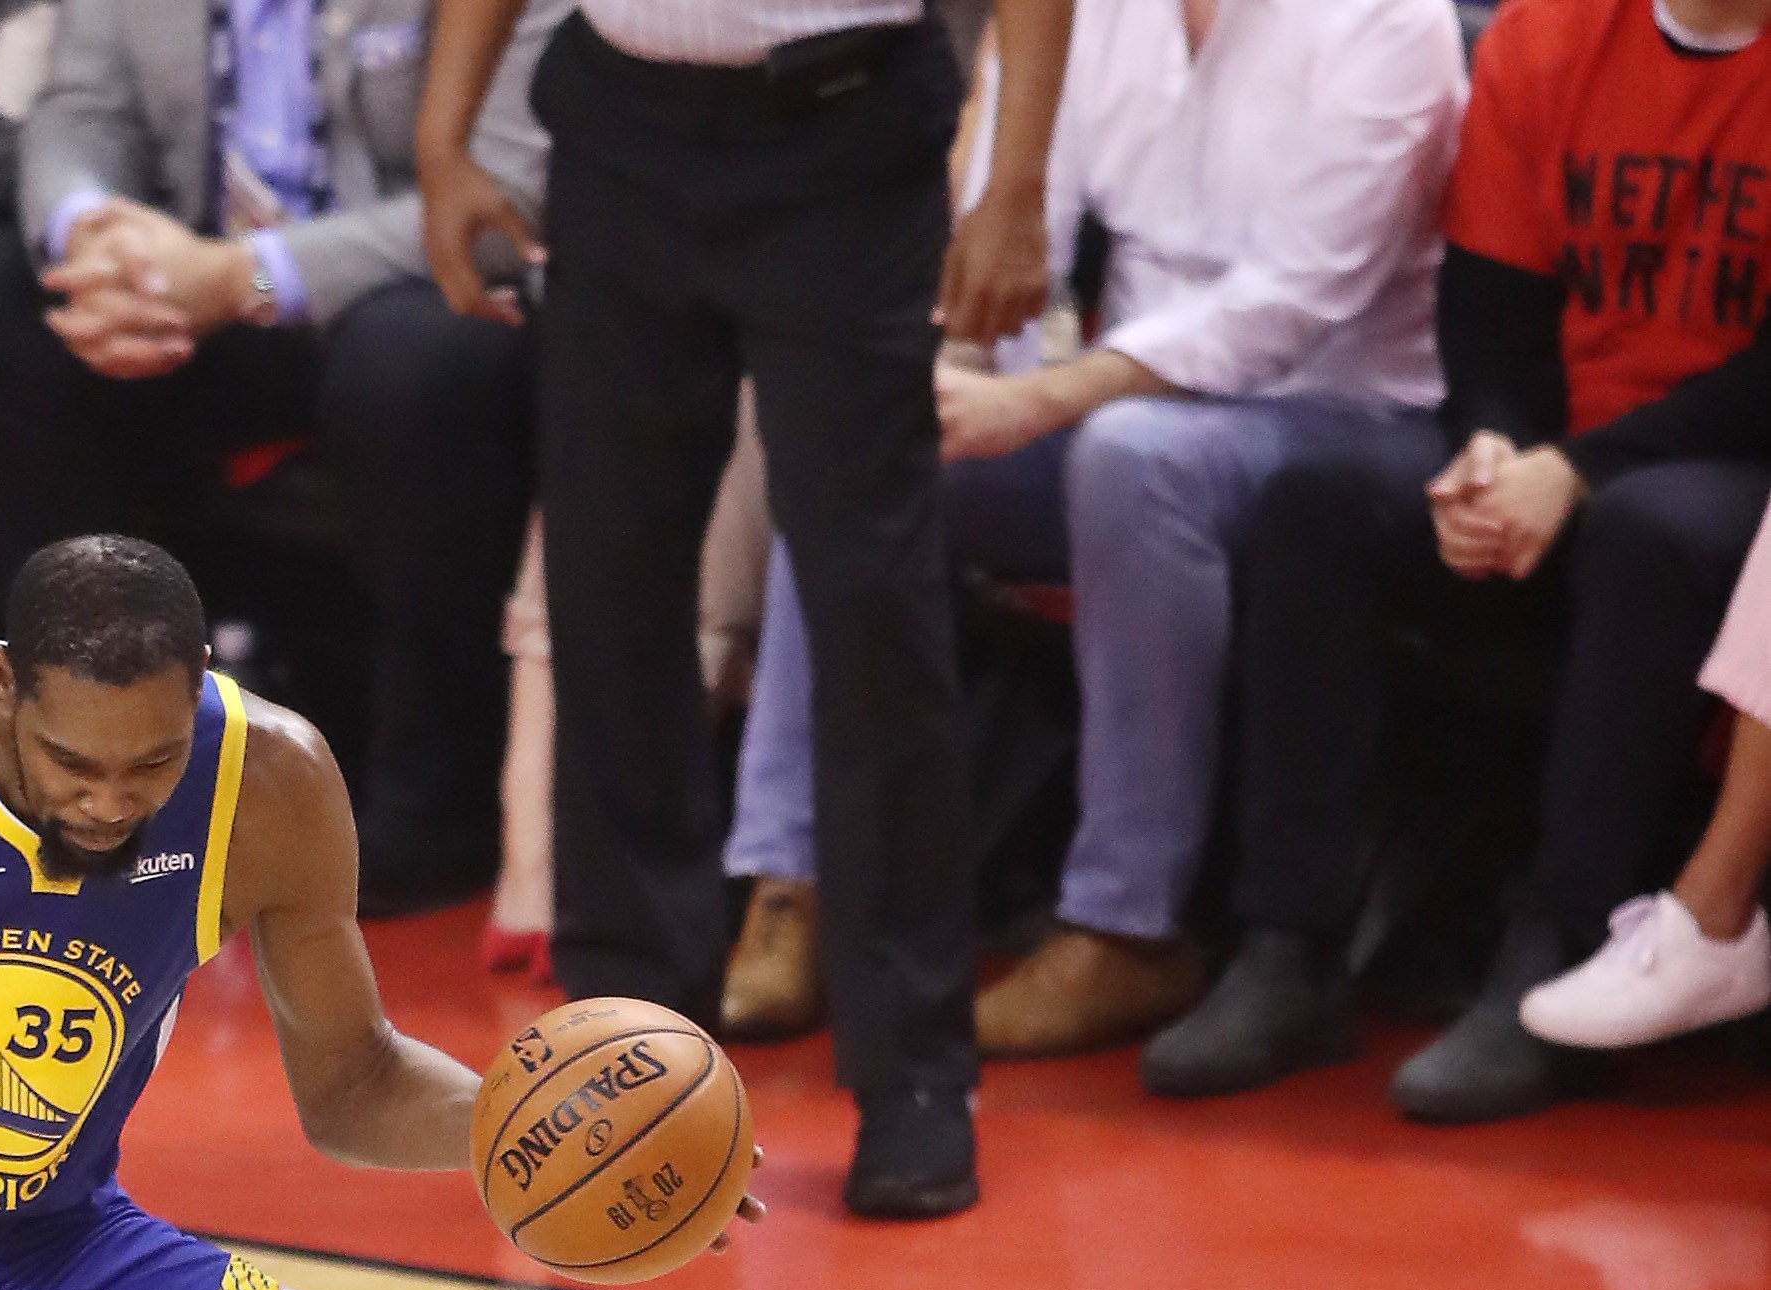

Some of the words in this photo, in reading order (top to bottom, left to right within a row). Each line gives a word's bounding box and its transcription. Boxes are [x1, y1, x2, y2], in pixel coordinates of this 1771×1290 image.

[135, 851, 195, 876] kuten
[64, 939, 142, 1005] STATE
[6, 1005, 98, 1064] 35
[498, 1040, 668, 1192] SPALDING
